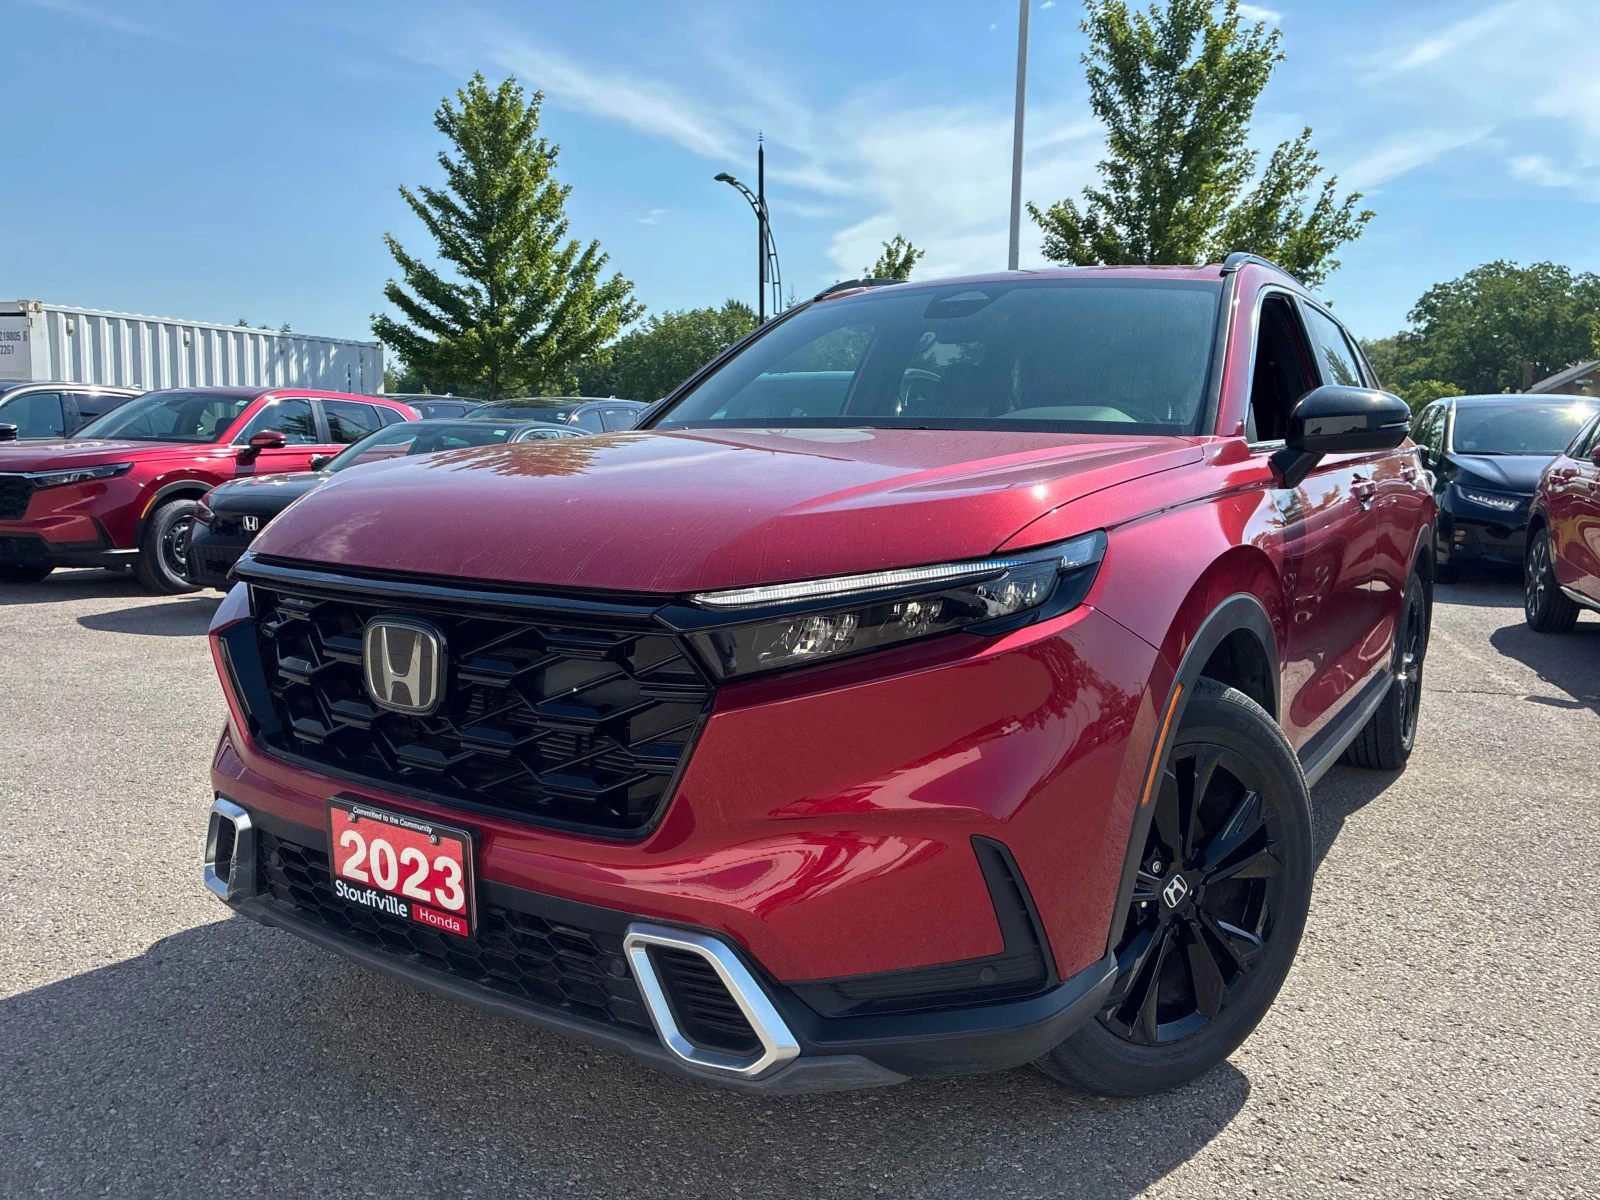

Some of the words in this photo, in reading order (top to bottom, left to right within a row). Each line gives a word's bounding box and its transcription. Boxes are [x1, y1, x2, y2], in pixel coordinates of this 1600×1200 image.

[353, 806, 382, 820] Committed
[383, 814, 389, 822] to
[390, 816, 399, 825] the
[400, 818, 433, 835] Community
[340, 830, 465, 911] 2023
[335, 879, 408, 917] Stouffville
[419, 908, 460, 931] Honda
